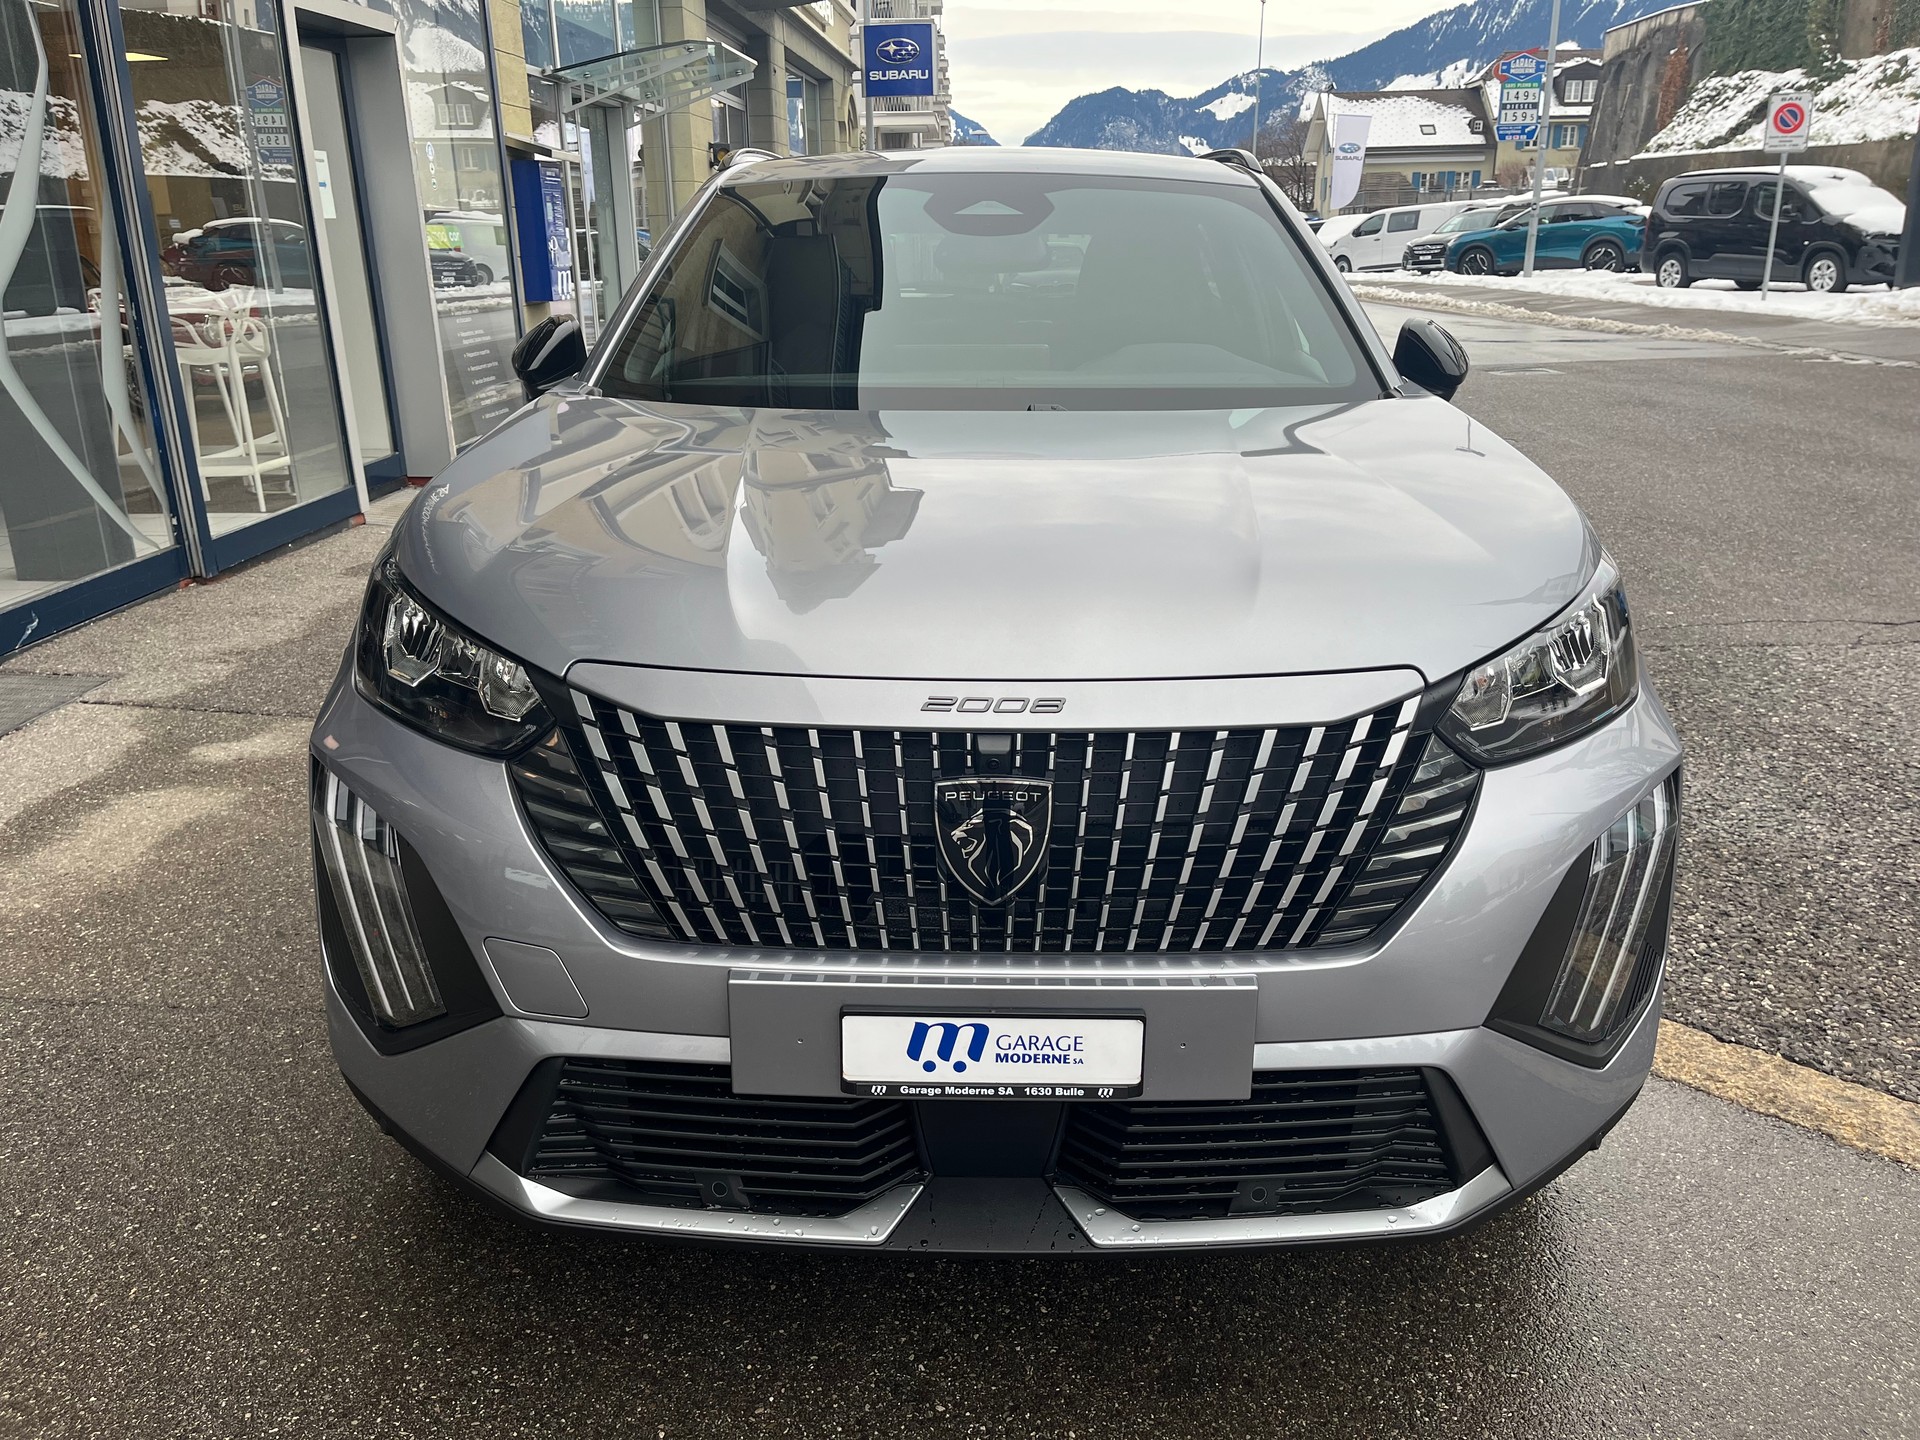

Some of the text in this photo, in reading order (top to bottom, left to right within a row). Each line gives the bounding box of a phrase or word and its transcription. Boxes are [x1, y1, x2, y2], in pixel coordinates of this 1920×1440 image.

[1511, 58, 1536, 68] GARAGE
[869, 69, 929, 81] SUBARU
[920, 696, 1067, 713] 2008
[945, 791, 1042, 802] PEUGEOT
[995, 1034, 1084, 1052] GARAGE
[995, 1053, 1071, 1065] MODERNE
[900, 1085, 1085, 1096] Garage Moderne SA 1630 Bulle
